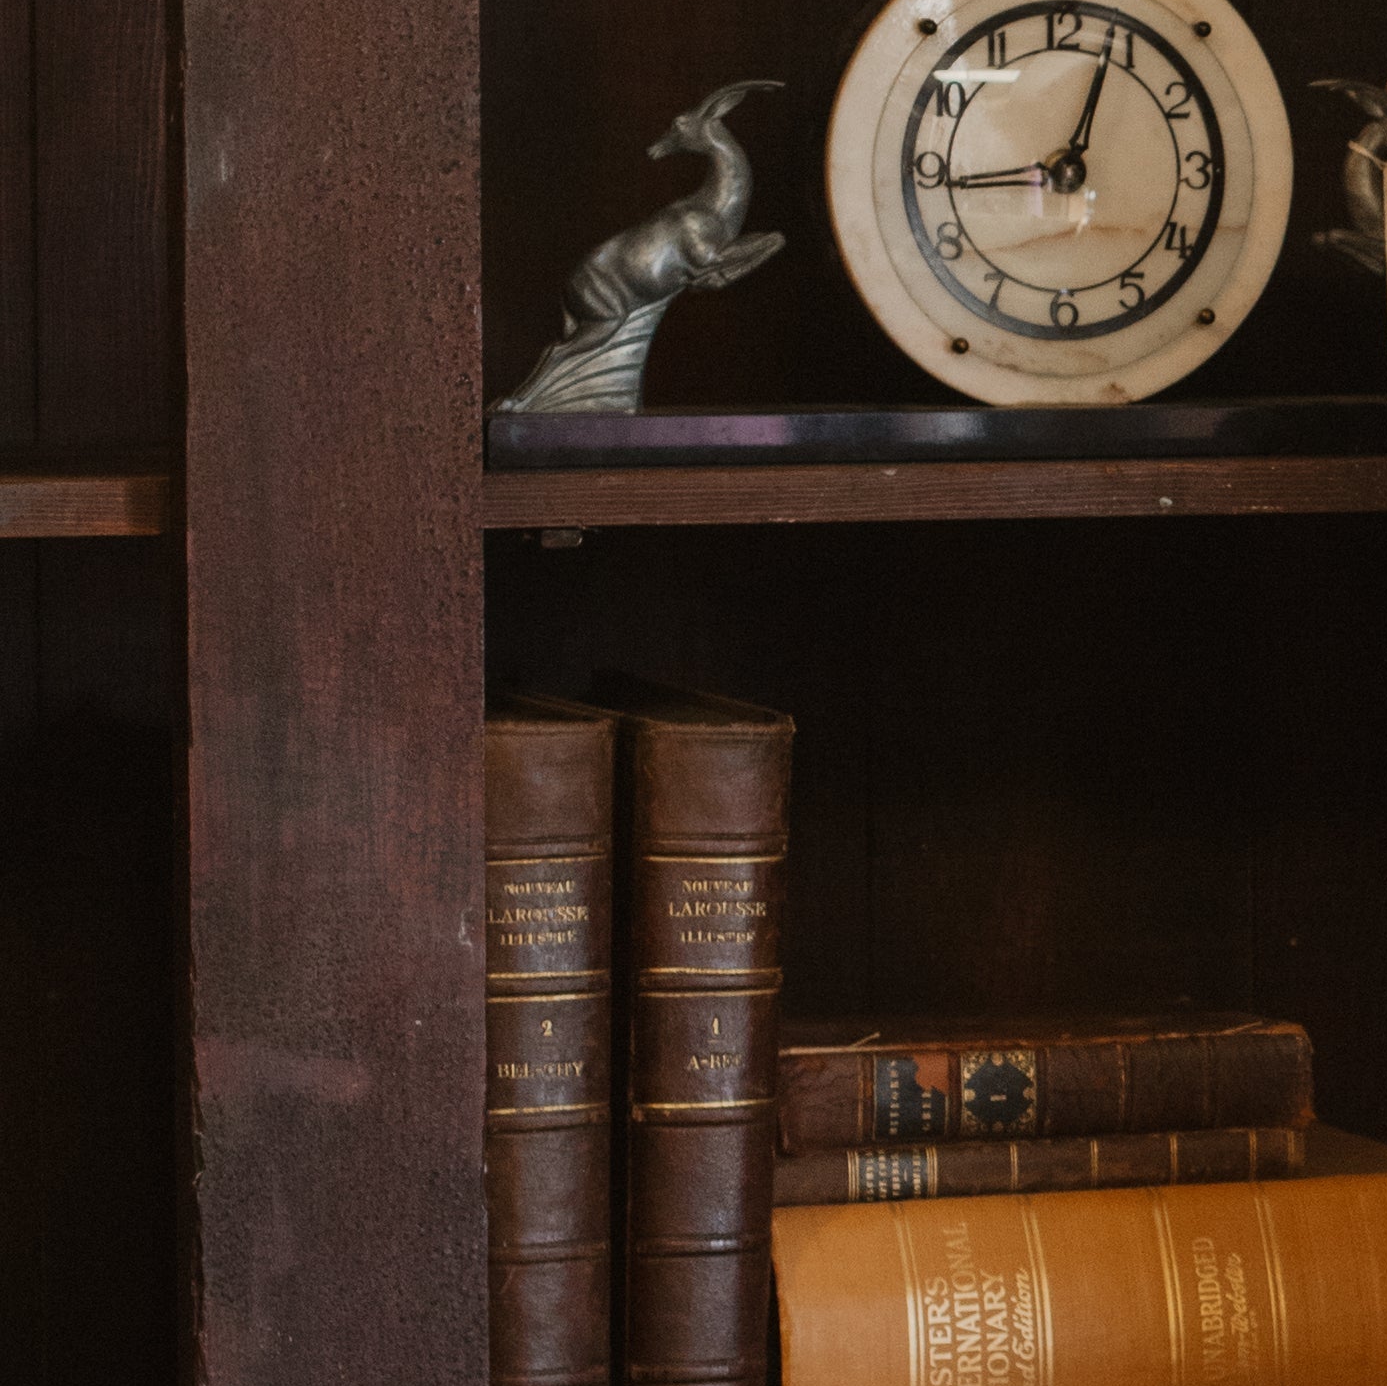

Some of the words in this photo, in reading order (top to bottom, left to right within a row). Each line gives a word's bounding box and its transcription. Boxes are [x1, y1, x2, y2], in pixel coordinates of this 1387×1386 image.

[1044, 5, 1084, 52] 12
[987, 31, 1007, 68] 11
[1165, 81, 1194, 119] 2
[915, 151, 948, 190] 9
[1185, 152, 1212, 190] 3
[935, 221, 964, 261] 8
[1164, 222, 1195, 260] 4
[984, 274, 1004, 311] 7
[1051, 290, 1079, 329] 6
[1119, 272, 1146, 311] 5
[486, 905, 591, 924] LAROUSSE
[667, 901, 768, 918] LAROUSSE
[540, 1019, 555, 1037] 2
[711, 1016, 722, 1036] 1
[1009, 1265, 1036, 1360] Edition
[1191, 1236, 1226, 1381] UNABRIDGED
